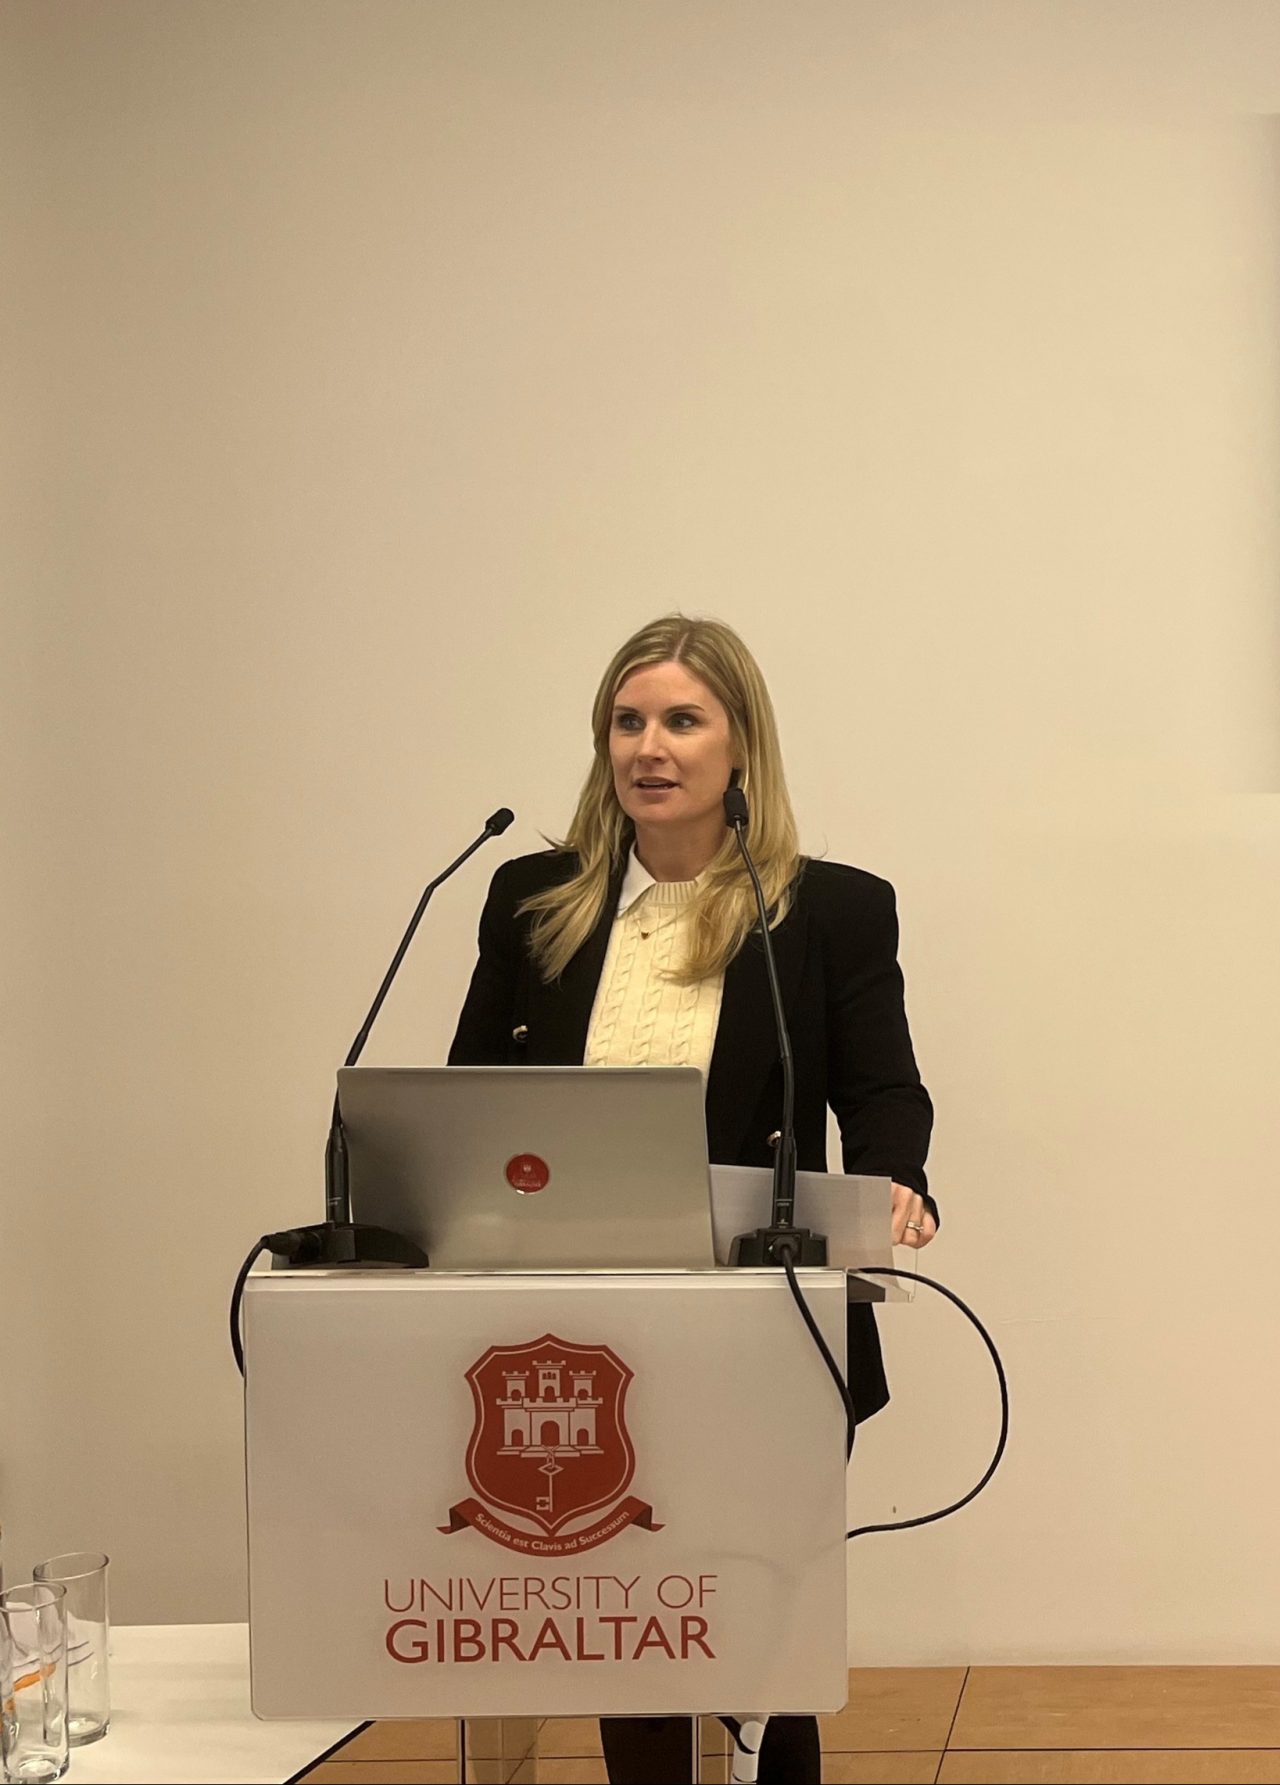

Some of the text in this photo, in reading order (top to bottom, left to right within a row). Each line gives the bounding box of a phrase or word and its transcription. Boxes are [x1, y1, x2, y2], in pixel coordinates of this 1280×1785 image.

[475, 1510, 631, 1551] Scientia est Clavis ad Successum
[384, 1575, 718, 1612] UNIVERSITY OF
[385, 1615, 716, 1663] GIBRALTAR
